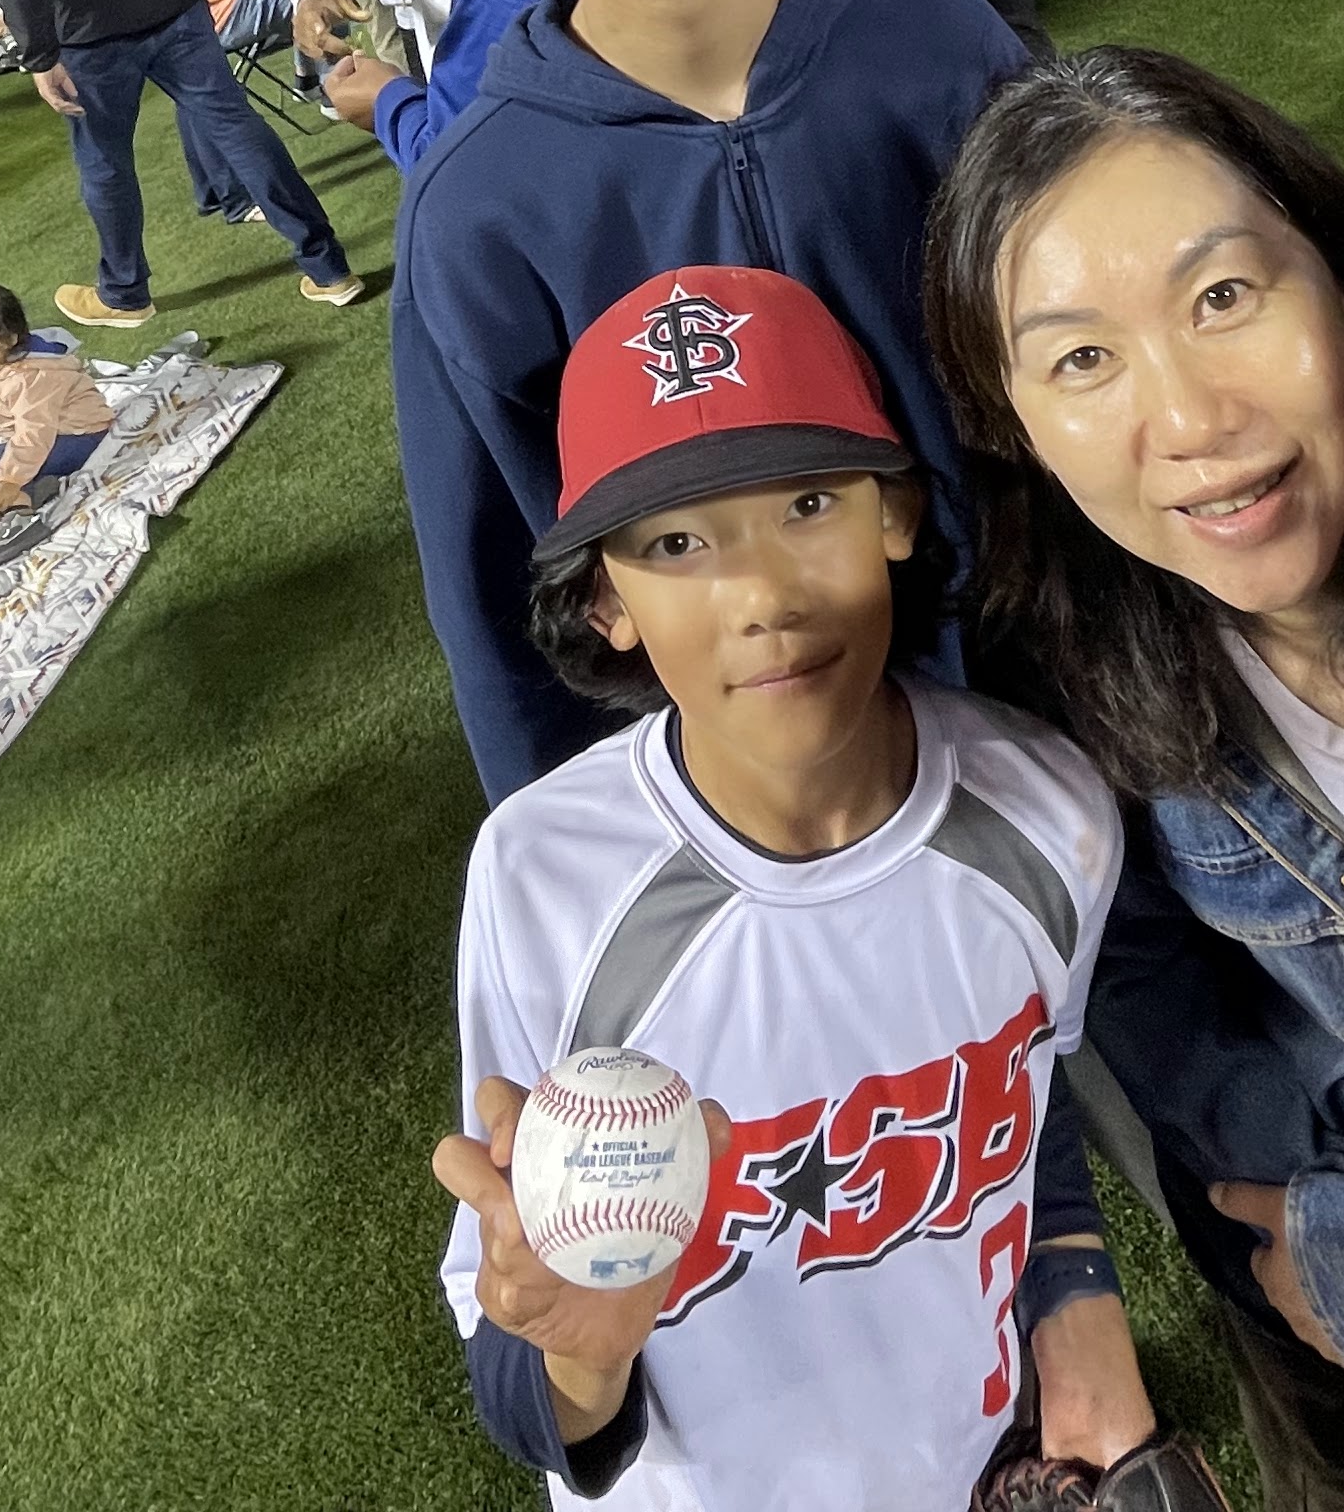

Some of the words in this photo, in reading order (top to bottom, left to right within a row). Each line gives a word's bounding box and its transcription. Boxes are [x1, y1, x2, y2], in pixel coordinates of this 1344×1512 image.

[602, 1140, 638, 1152] OFFICIAL
[598, 1152, 632, 1168] LEAGUE
[634, 1147, 676, 1165] BASEBALL
